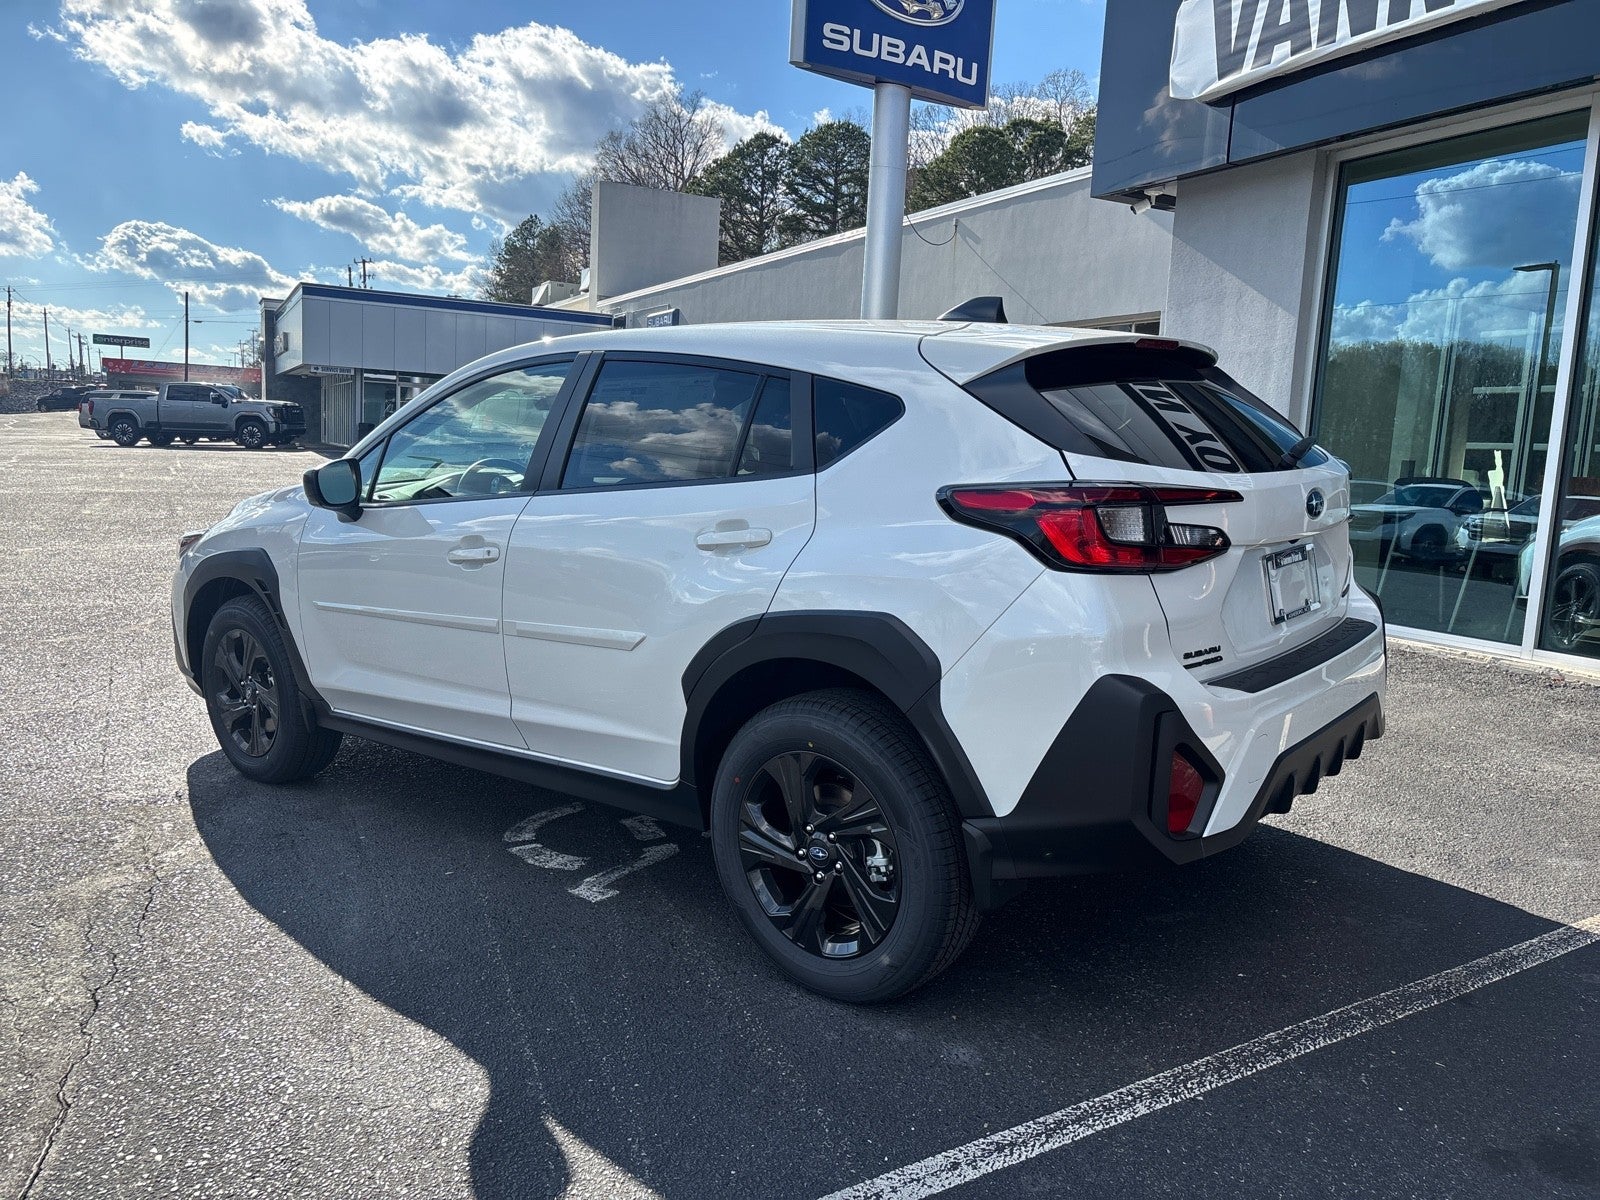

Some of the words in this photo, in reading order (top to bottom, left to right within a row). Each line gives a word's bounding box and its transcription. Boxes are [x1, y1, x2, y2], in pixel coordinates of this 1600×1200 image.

[822, 22, 978, 86] SUBARU
[1213, 0, 1458, 82] VAN
[1183, 645, 1221, 660] SUBARU
